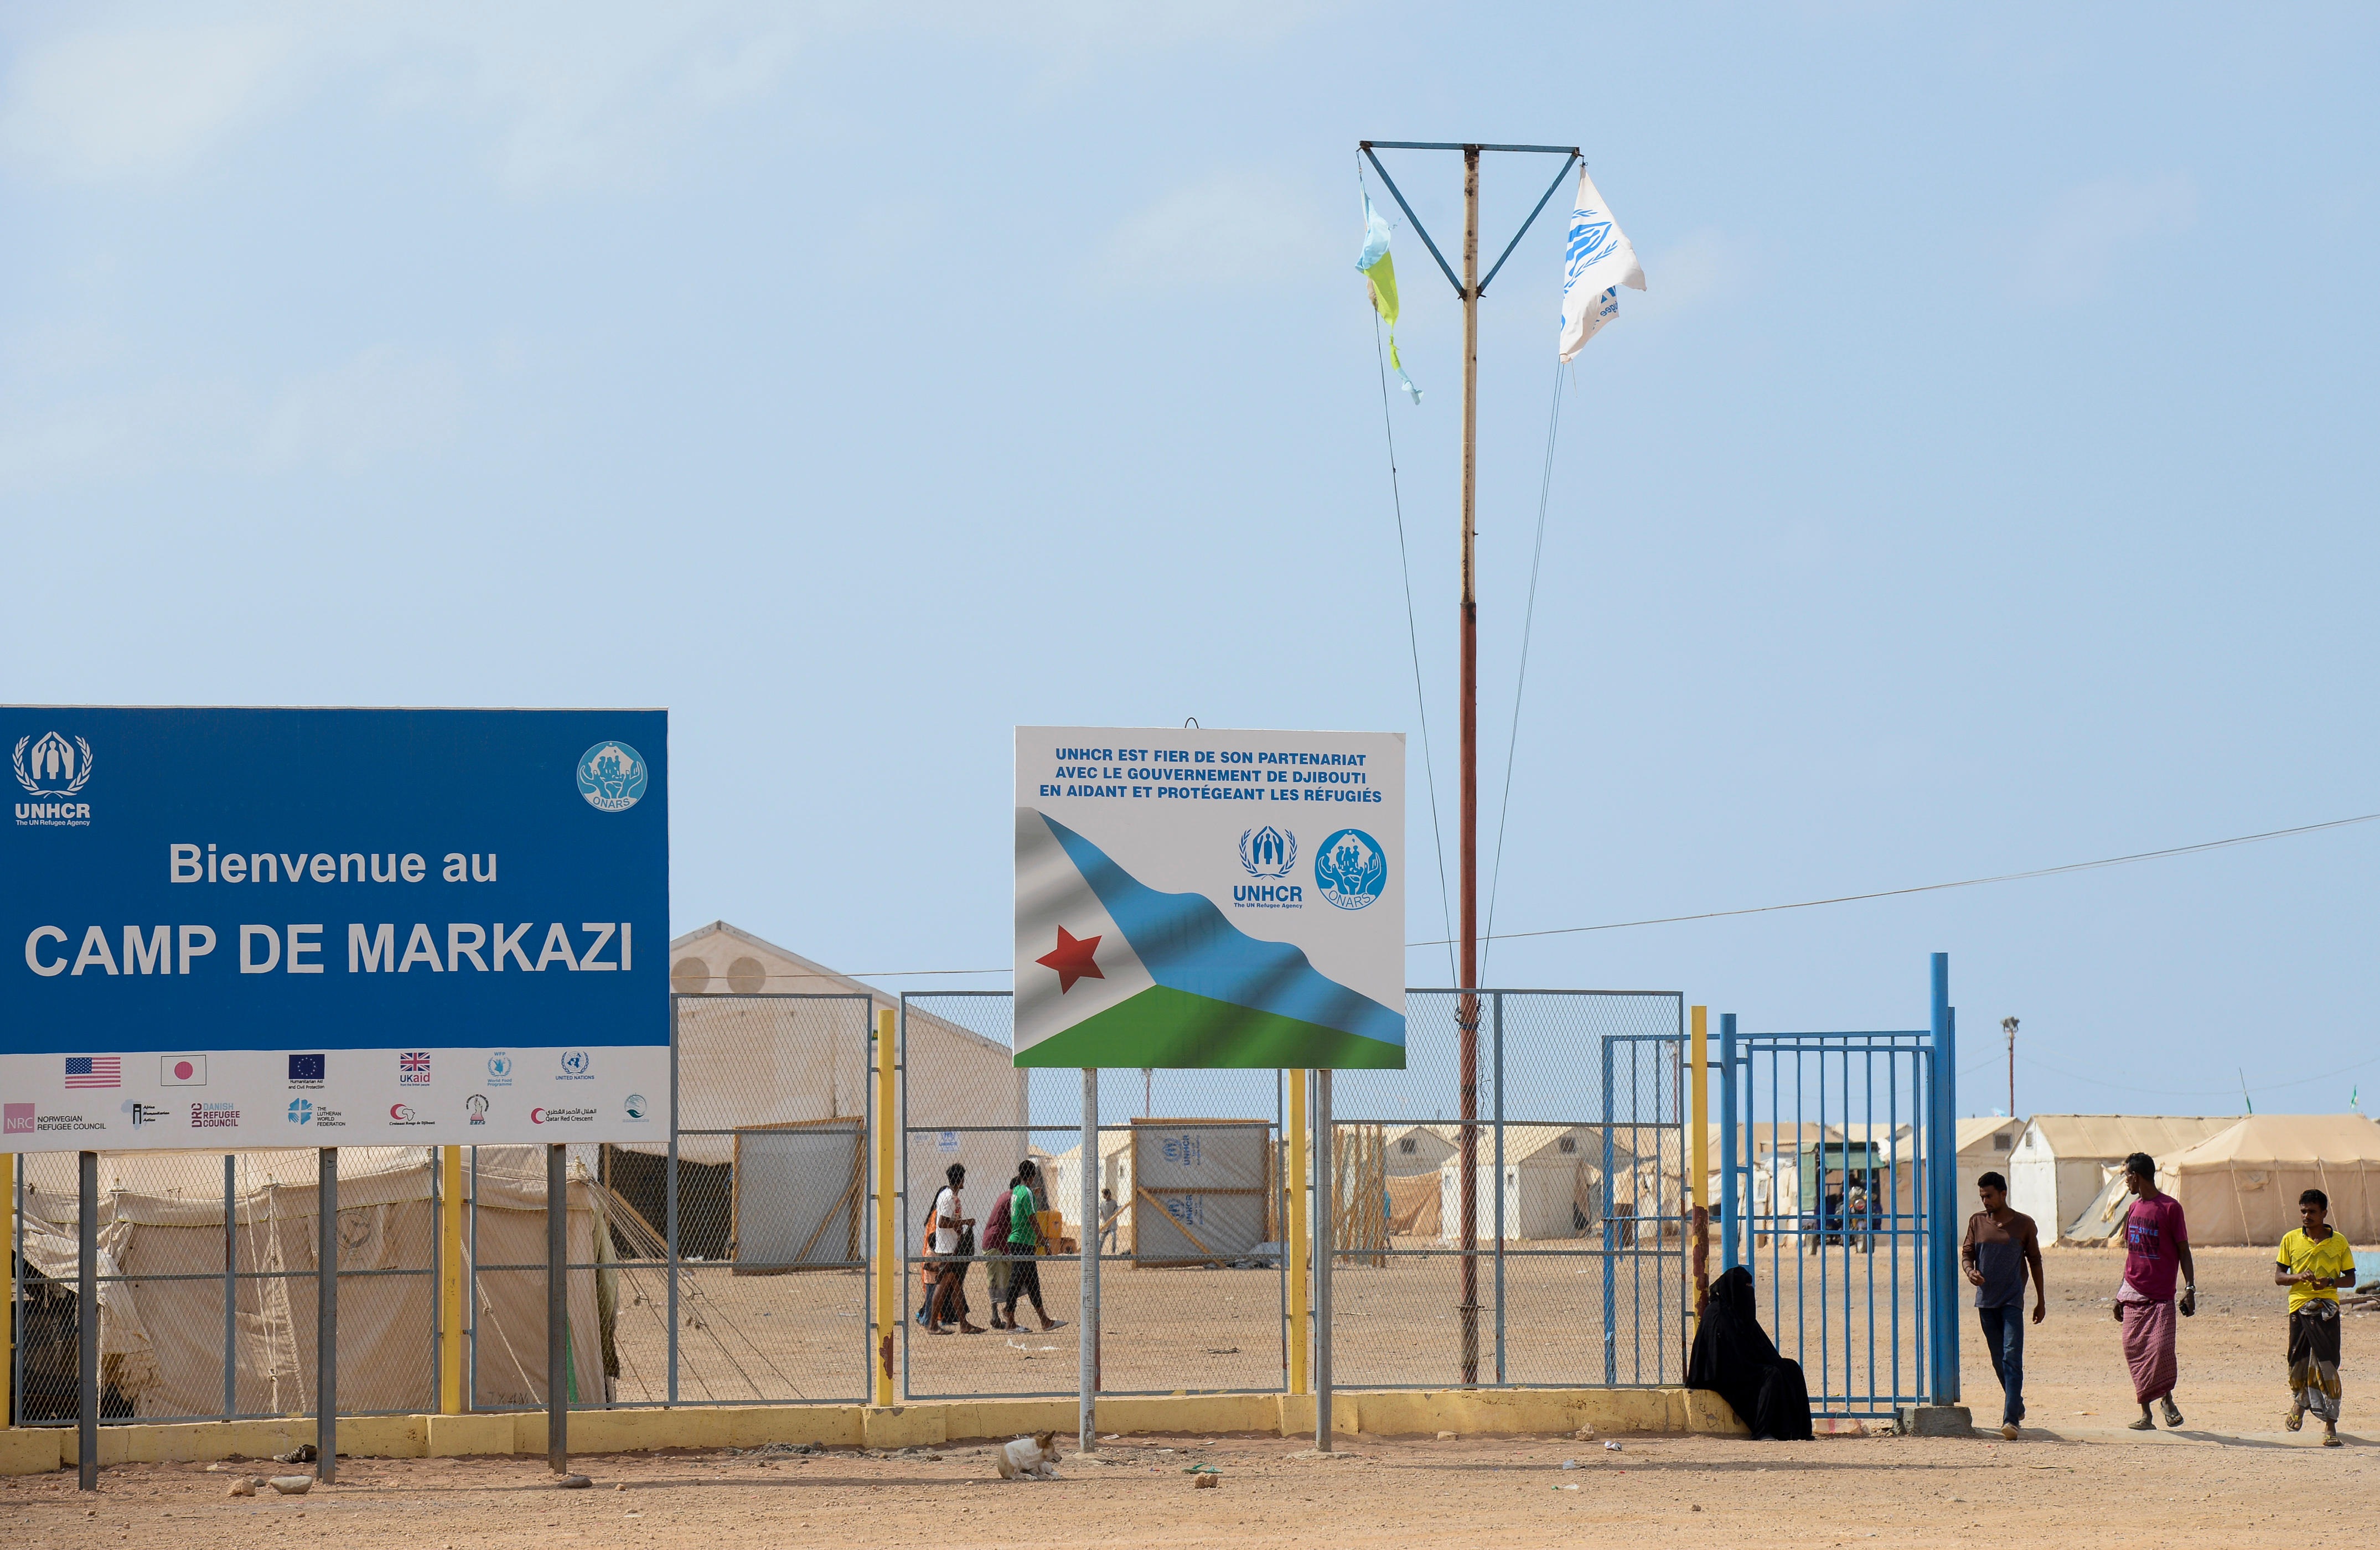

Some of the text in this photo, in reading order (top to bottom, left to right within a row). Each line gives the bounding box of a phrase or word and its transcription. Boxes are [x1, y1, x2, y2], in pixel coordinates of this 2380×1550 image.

[1056, 748, 1366, 766] UNHCR EST FIER DE SON PARTENARIAT
[1056, 766, 1366, 784] AVEC LE GOUVERNEMENT DE DJIBOUTI
[1040, 784, 1382, 803] EN AIDANT ET PROTÉGEANT LES RÉFUGIÉS
[15, 802, 90, 818] UNHCR
[592, 796, 630, 810] ONARS
[170, 843, 496, 883] Bienvenue au
[1234, 885, 1302, 902] UNHCR
[1328, 889, 1371, 908] ONARS
[25, 922, 632, 977] CAMP DE MARKAZI
[400, 1072, 430, 1083] UKaid
[7, 1117, 33, 1129] NRC
[191, 1102, 203, 1128] DRC
[203, 1111, 240, 1119] REFUGEE
[203, 1119, 239, 1127] COUNCIL
[2138, 1227, 2158, 1235] STYLE
